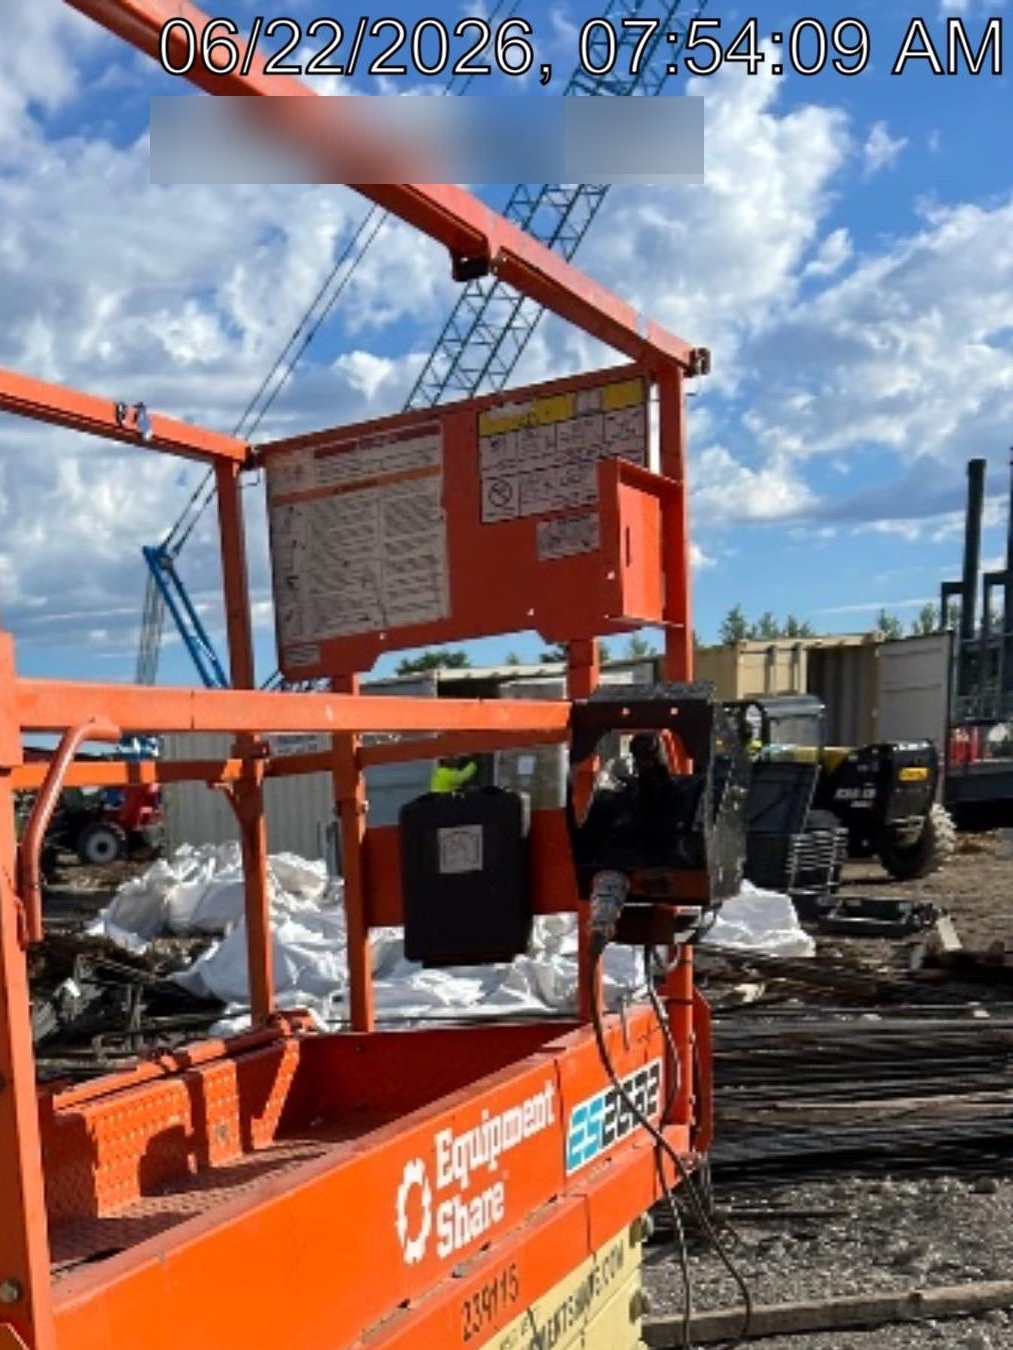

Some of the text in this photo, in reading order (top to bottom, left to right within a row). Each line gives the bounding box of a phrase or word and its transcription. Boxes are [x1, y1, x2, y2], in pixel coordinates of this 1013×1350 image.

[435, 1080, 555, 1190] Equipment
[566, 1057, 662, 1175] ES2632
[437, 1181, 505, 1259] Share
[463, 1262, 520, 1342] 239115
